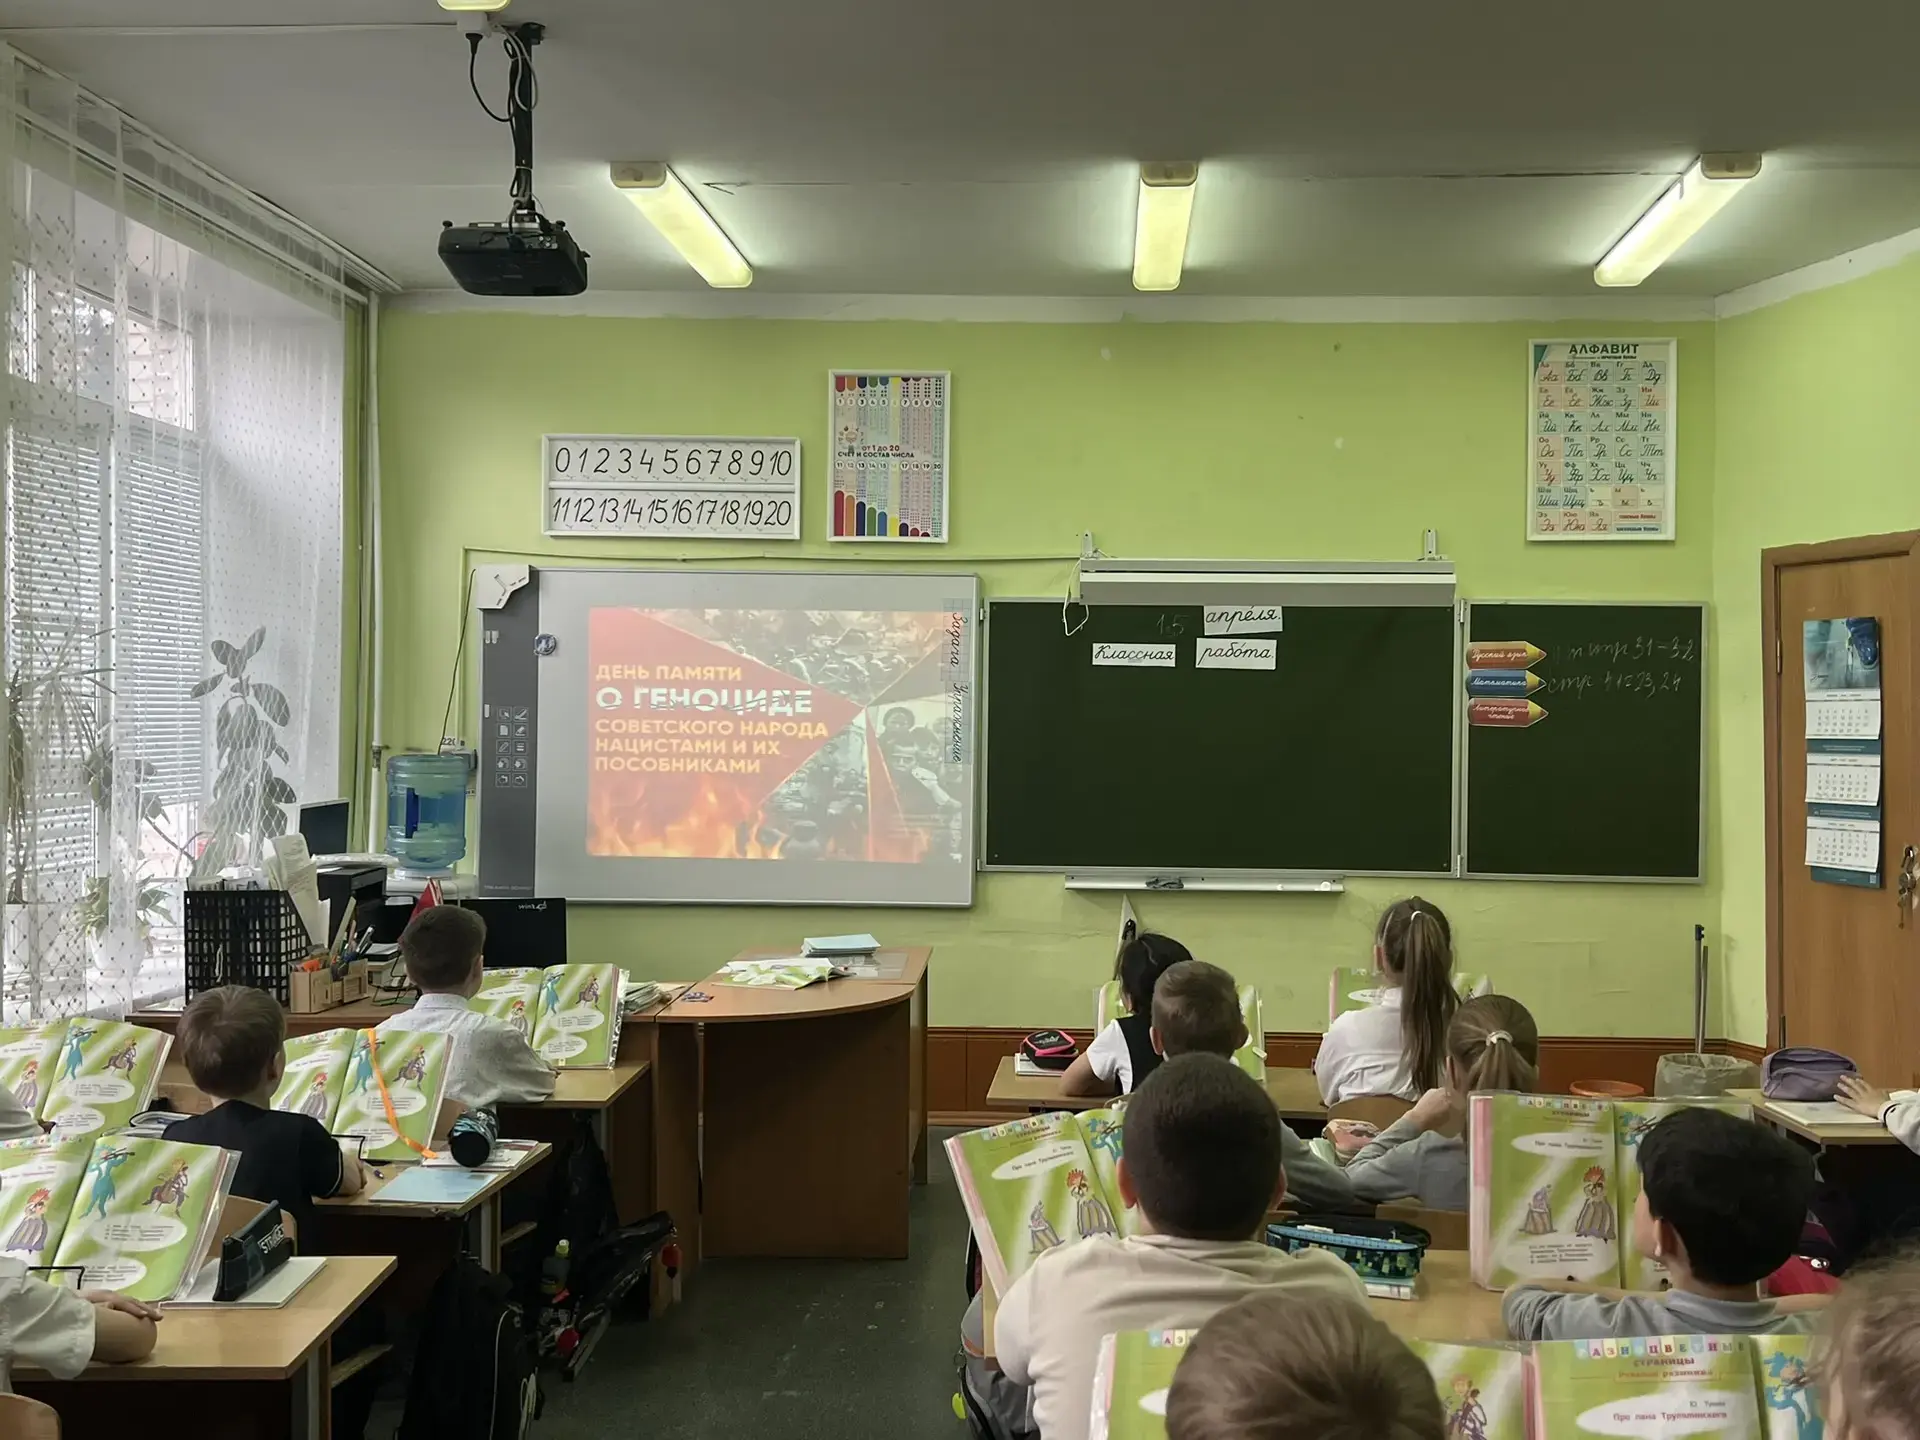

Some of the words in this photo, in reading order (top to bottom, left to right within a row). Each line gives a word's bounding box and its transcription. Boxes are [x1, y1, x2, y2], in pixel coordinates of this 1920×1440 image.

[1569, 344, 1639, 354] АЛФАВИТ
[555, 448, 570, 473] 0
[579, 448, 588, 473] 1
[594, 448, 610, 473] 2
[618, 448, 631, 474] 3
[640, 449, 654, 474] 4
[663, 449, 678, 474] 5
[686, 449, 701, 474] 6
[707, 450, 722, 475] 7
[728, 450, 743, 475] 8
[749, 450, 764, 475] 9
[770, 451, 792, 476] 10
[553, 497, 571, 522] 11
[574, 498, 595, 522] 12
[599, 498, 618, 523] 13
[623, 498, 643, 523] 14
[647, 499, 668, 524] 15
[672, 500, 693, 524] 16
[696, 500, 718, 524] 17
[720, 500, 740, 525] 18
[744, 500, 764, 525] 19
[764, 501, 791, 526] 20
[945, 612, 968, 667] Задача
[1094, 644, 1174, 660] Классная
[1472, 648, 1505, 662] Русский
[596, 665, 649, 682] ДЕНЬ
[656, 665, 742, 682] ПАМЯТИ
[1471, 677, 1527, 686] Математика
[595, 687, 622, 711] О
[634, 686, 813, 717] ГЕНОЦИДЕ
[595, 718, 733, 736] СОВЕТСКОГО
[740, 721, 828, 740] НАРОДА
[948, 682, 968, 763] Упражнение
[596, 738, 727, 757] НАЦИСТАМИ
[733, 741, 748, 755] И
[753, 741, 780, 756] ИХ
[595, 756, 760, 774] ПОСОБНИКАМИ
